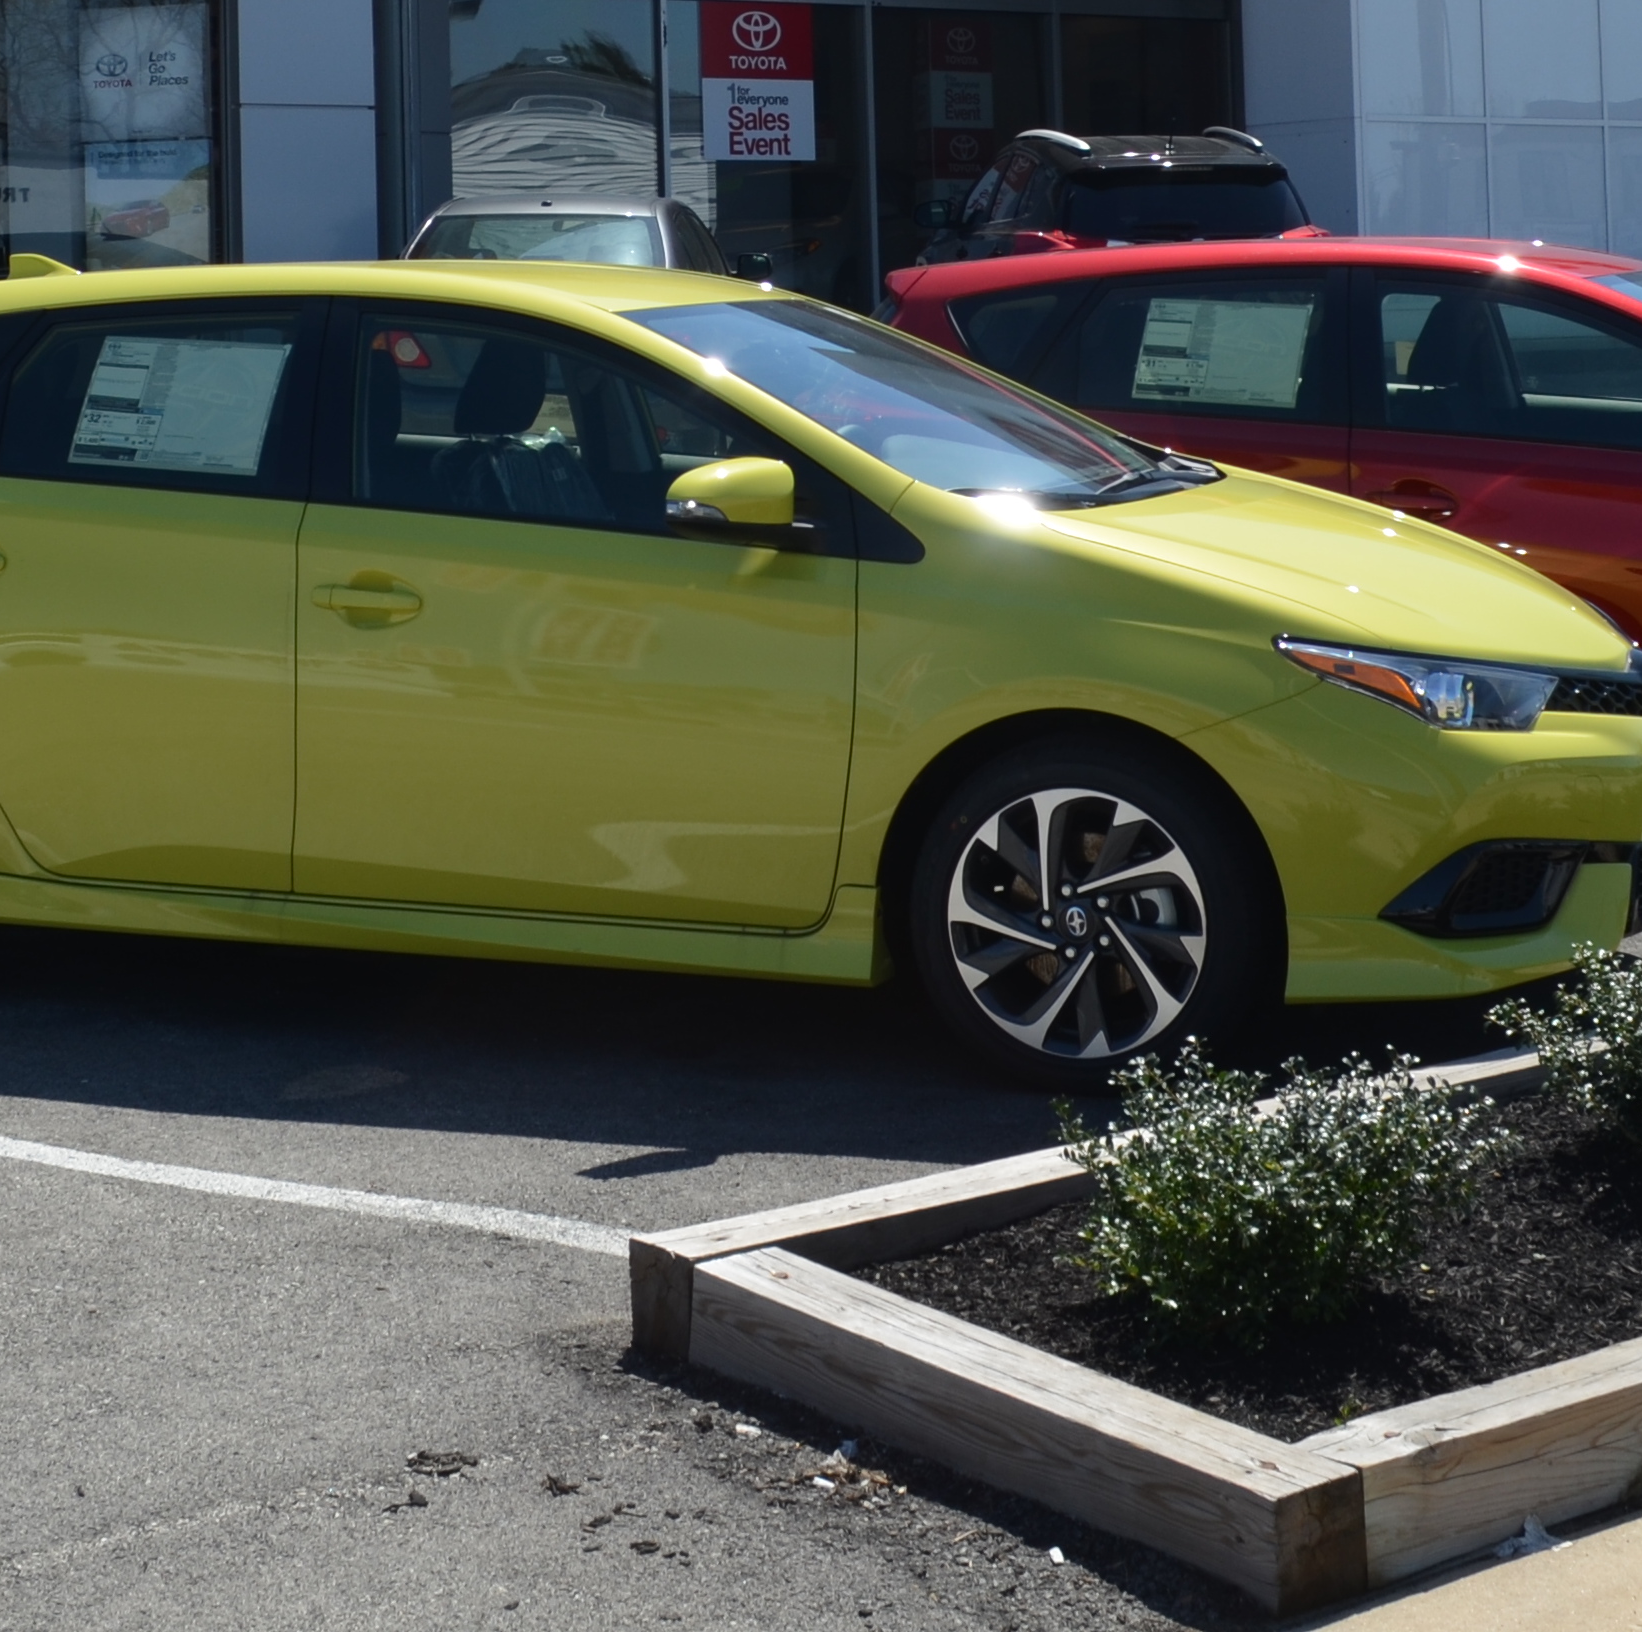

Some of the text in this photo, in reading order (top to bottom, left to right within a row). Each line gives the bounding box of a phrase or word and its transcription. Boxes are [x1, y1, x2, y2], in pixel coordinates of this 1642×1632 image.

[149, 51, 176, 62] Let's
[729, 55, 787, 70] TOYOTA
[945, 55, 978, 65] TOYOTA
[149, 63, 165, 74] Go
[93, 79, 132, 89] TOYOTA
[149, 75, 189, 86] Places
[727, 83, 750, 104] 1 for
[945, 89, 980, 105] Sales
[737, 95, 789, 107] everyone
[728, 106, 790, 131] Sales
[945, 105, 981, 121] Event
[729, 131, 791, 156] Event
[87, 414, 101, 424] 32
